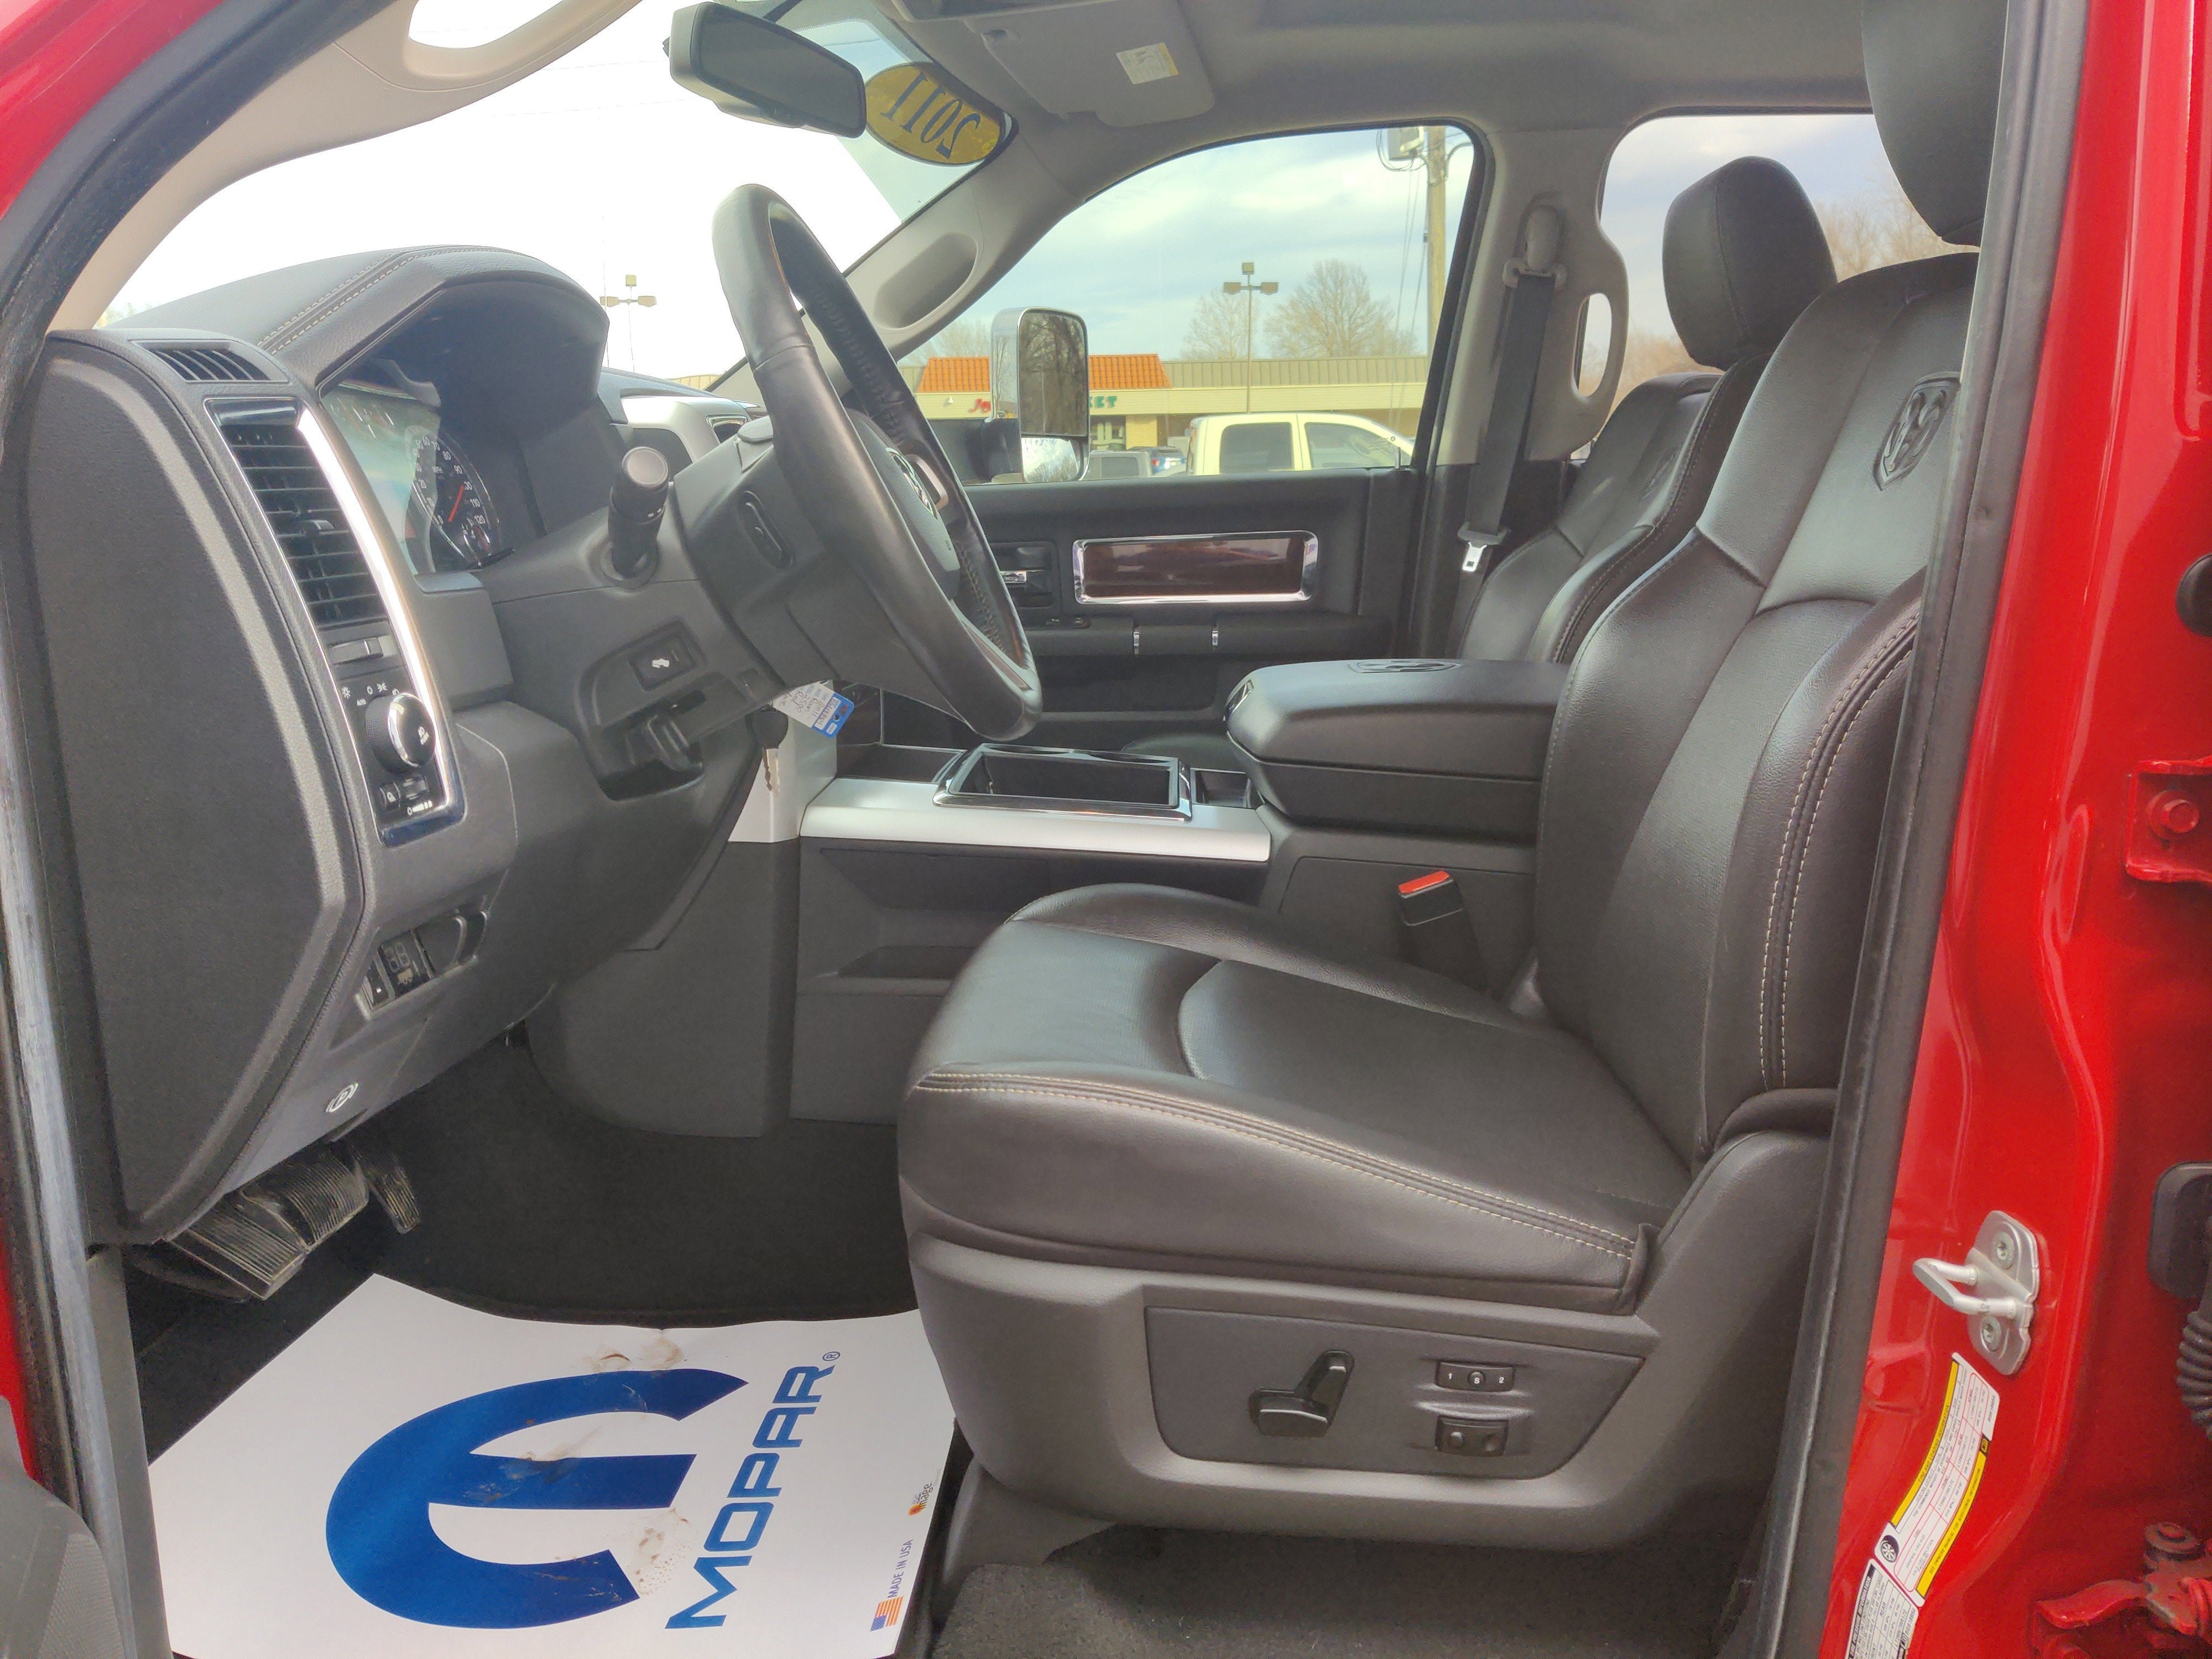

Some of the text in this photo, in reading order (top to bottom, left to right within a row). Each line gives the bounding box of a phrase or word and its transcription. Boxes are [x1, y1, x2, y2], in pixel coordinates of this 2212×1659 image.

[442, 450, 452, 461] 80
[453, 465, 463, 474] 90
[463, 481, 473, 491] 00
[470, 498, 481, 508] 110
[474, 514, 486, 525] 120
[665, 1365, 835, 1629] MOPAR
[888, 1539, 913, 1598] MADE IN USA
